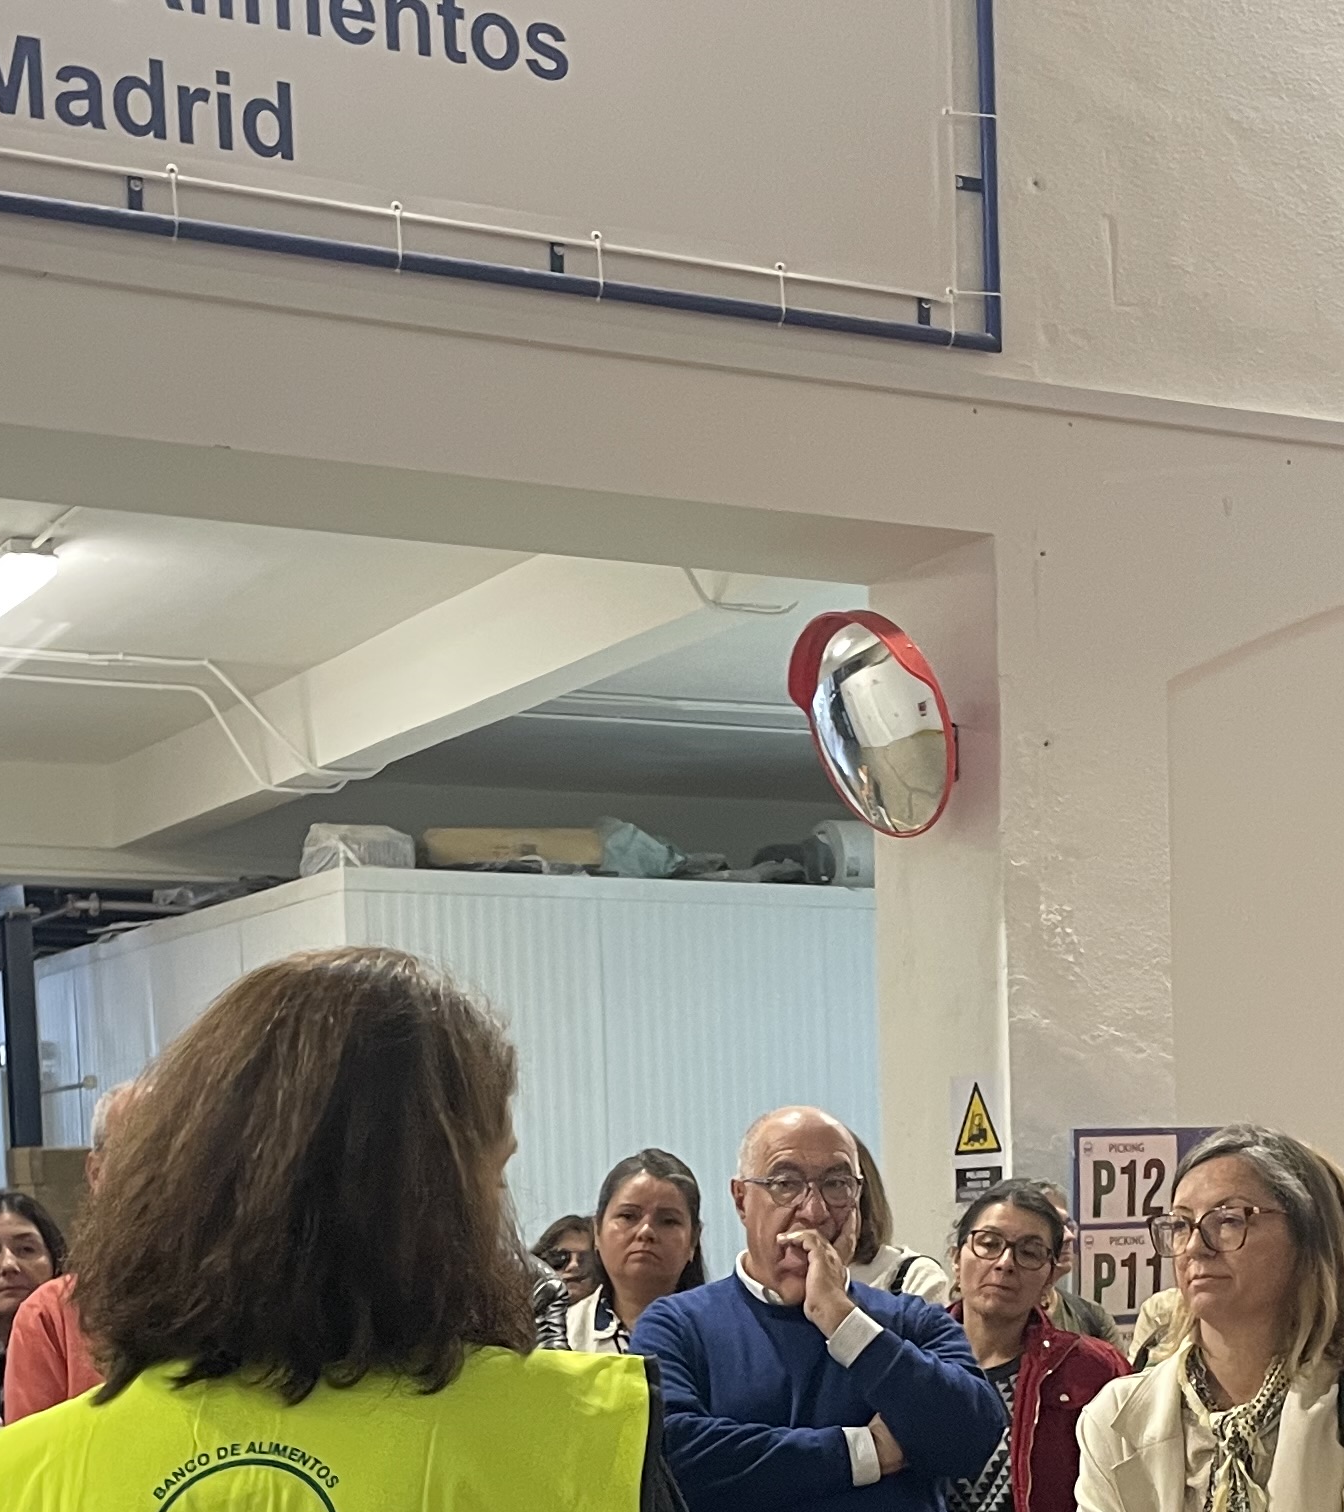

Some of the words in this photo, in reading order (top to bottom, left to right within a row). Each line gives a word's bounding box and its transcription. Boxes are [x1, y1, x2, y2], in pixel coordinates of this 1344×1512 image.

[163, 0, 569, 81] entos
[1092, 1158, 1166, 1218] P12
[152, 1453, 210, 1500] BANCO
[216, 1443, 241, 1460] DE
[244, 1441, 340, 1489] ALIMENTOS
